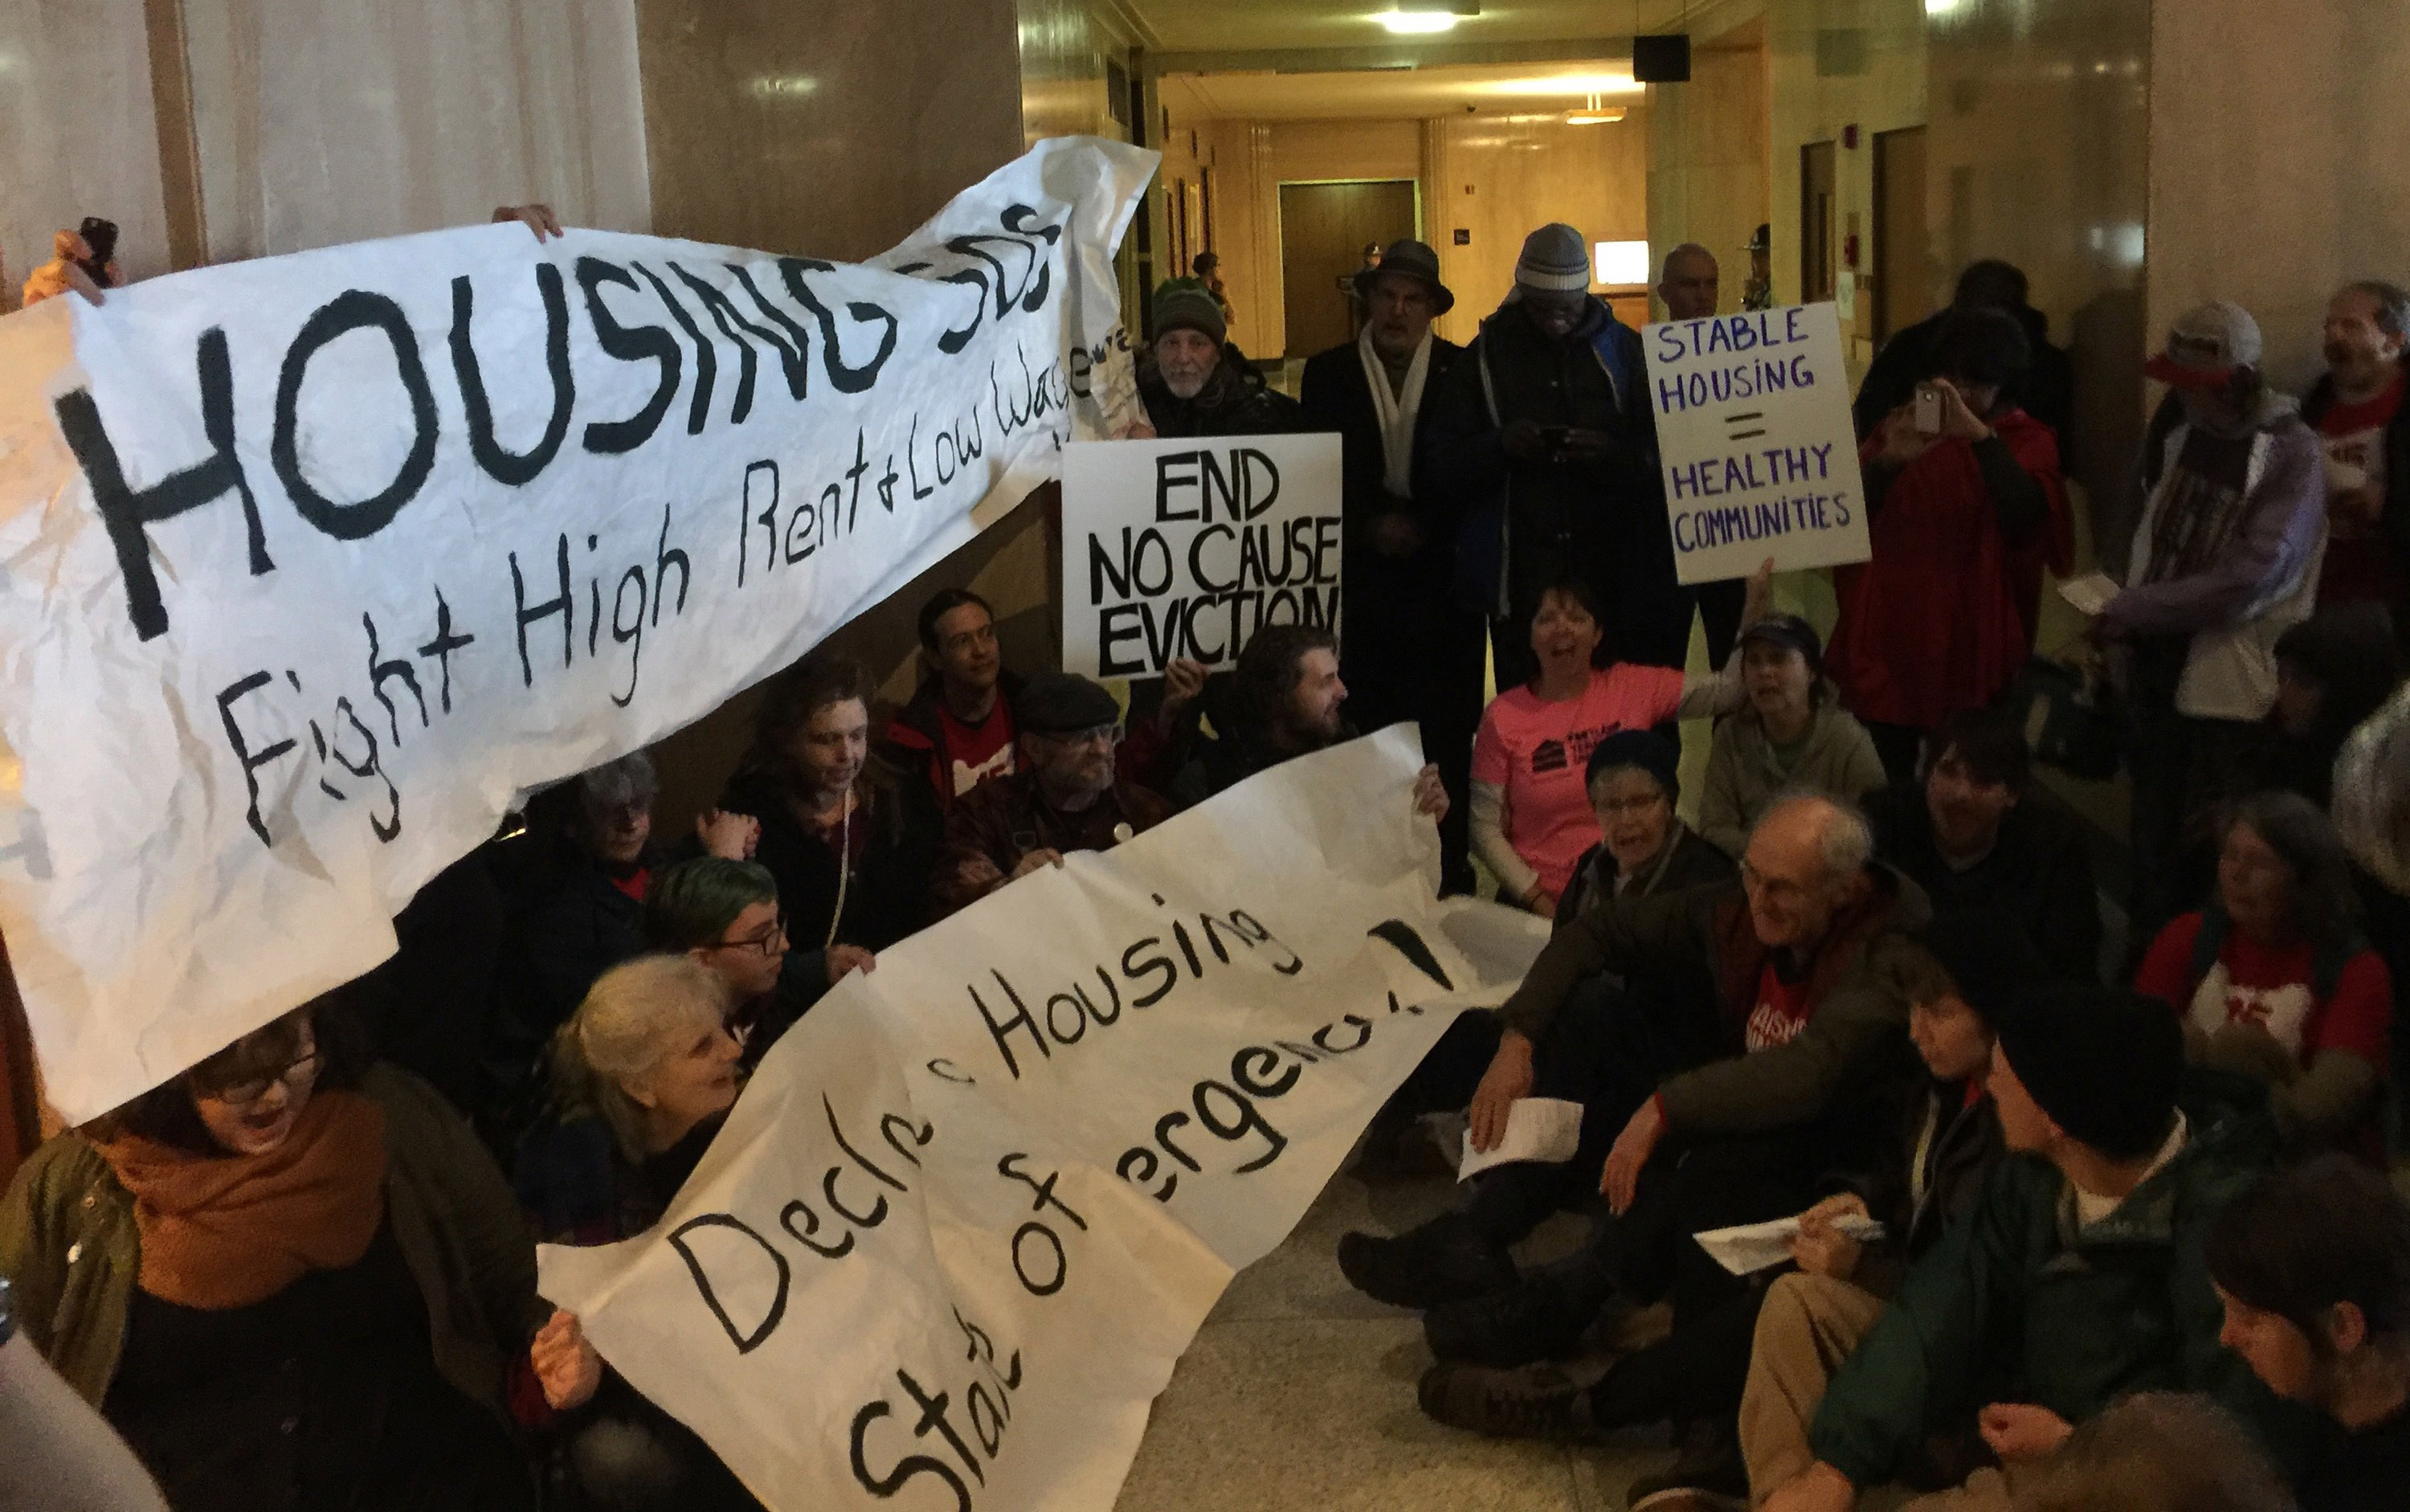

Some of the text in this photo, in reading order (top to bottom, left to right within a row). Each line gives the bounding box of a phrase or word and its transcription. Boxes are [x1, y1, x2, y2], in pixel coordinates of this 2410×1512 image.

[1657, 308, 1809, 364] STABLE
[53, 255, 898, 643] HOUSING
[1155, 448, 1281, 523] END
[1671, 443, 1832, 500] HEALTHY
[1088, 516, 1342, 605] NO CAUSE
[215, 582, 474, 848] Fight
[508, 503, 691, 709] High
[737, 426, 870, 588] Rent
[909, 413, 982, 500] Low
[998, 1152, 1088, 1297] of
